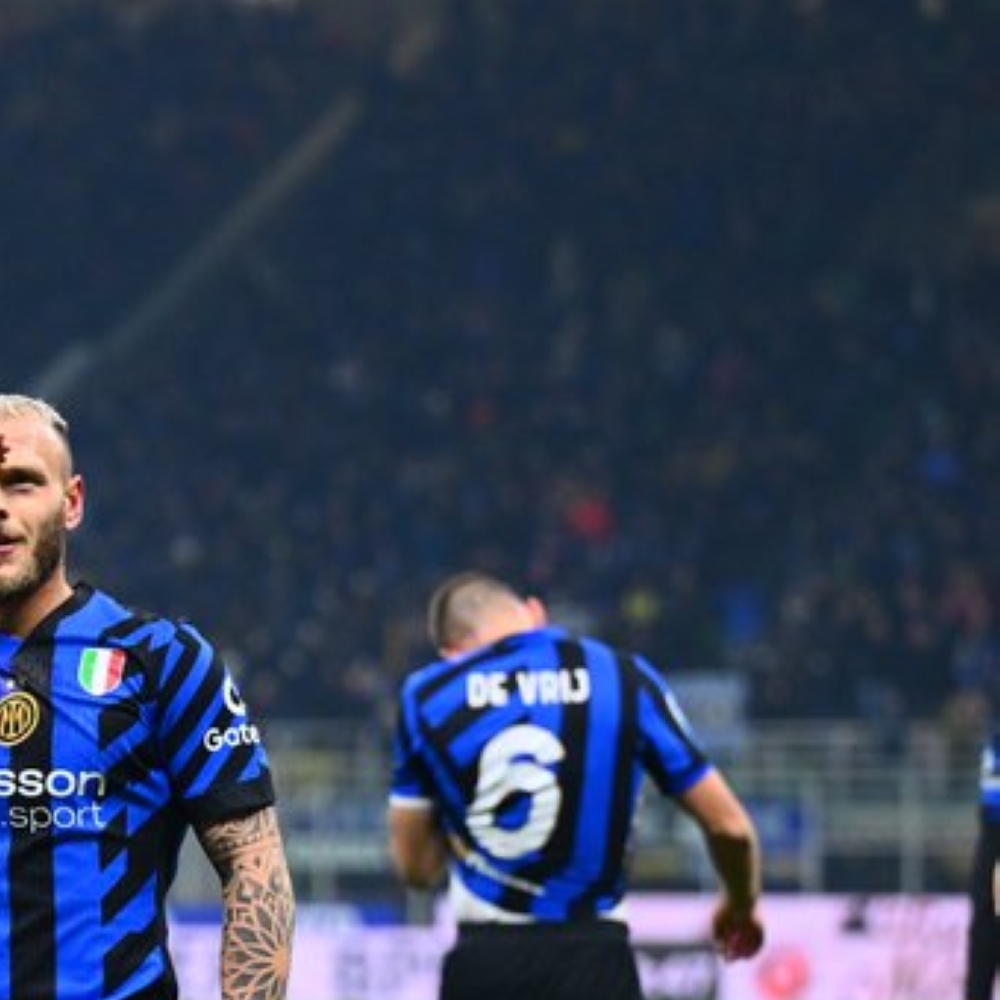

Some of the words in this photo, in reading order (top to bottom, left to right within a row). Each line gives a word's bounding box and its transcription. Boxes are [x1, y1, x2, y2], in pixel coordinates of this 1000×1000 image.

[467, 671, 509, 708] DE
[515, 668, 590, 705] VRIJ
[465, 724, 566, 860] 6
[0, 801, 108, 834] .sport
